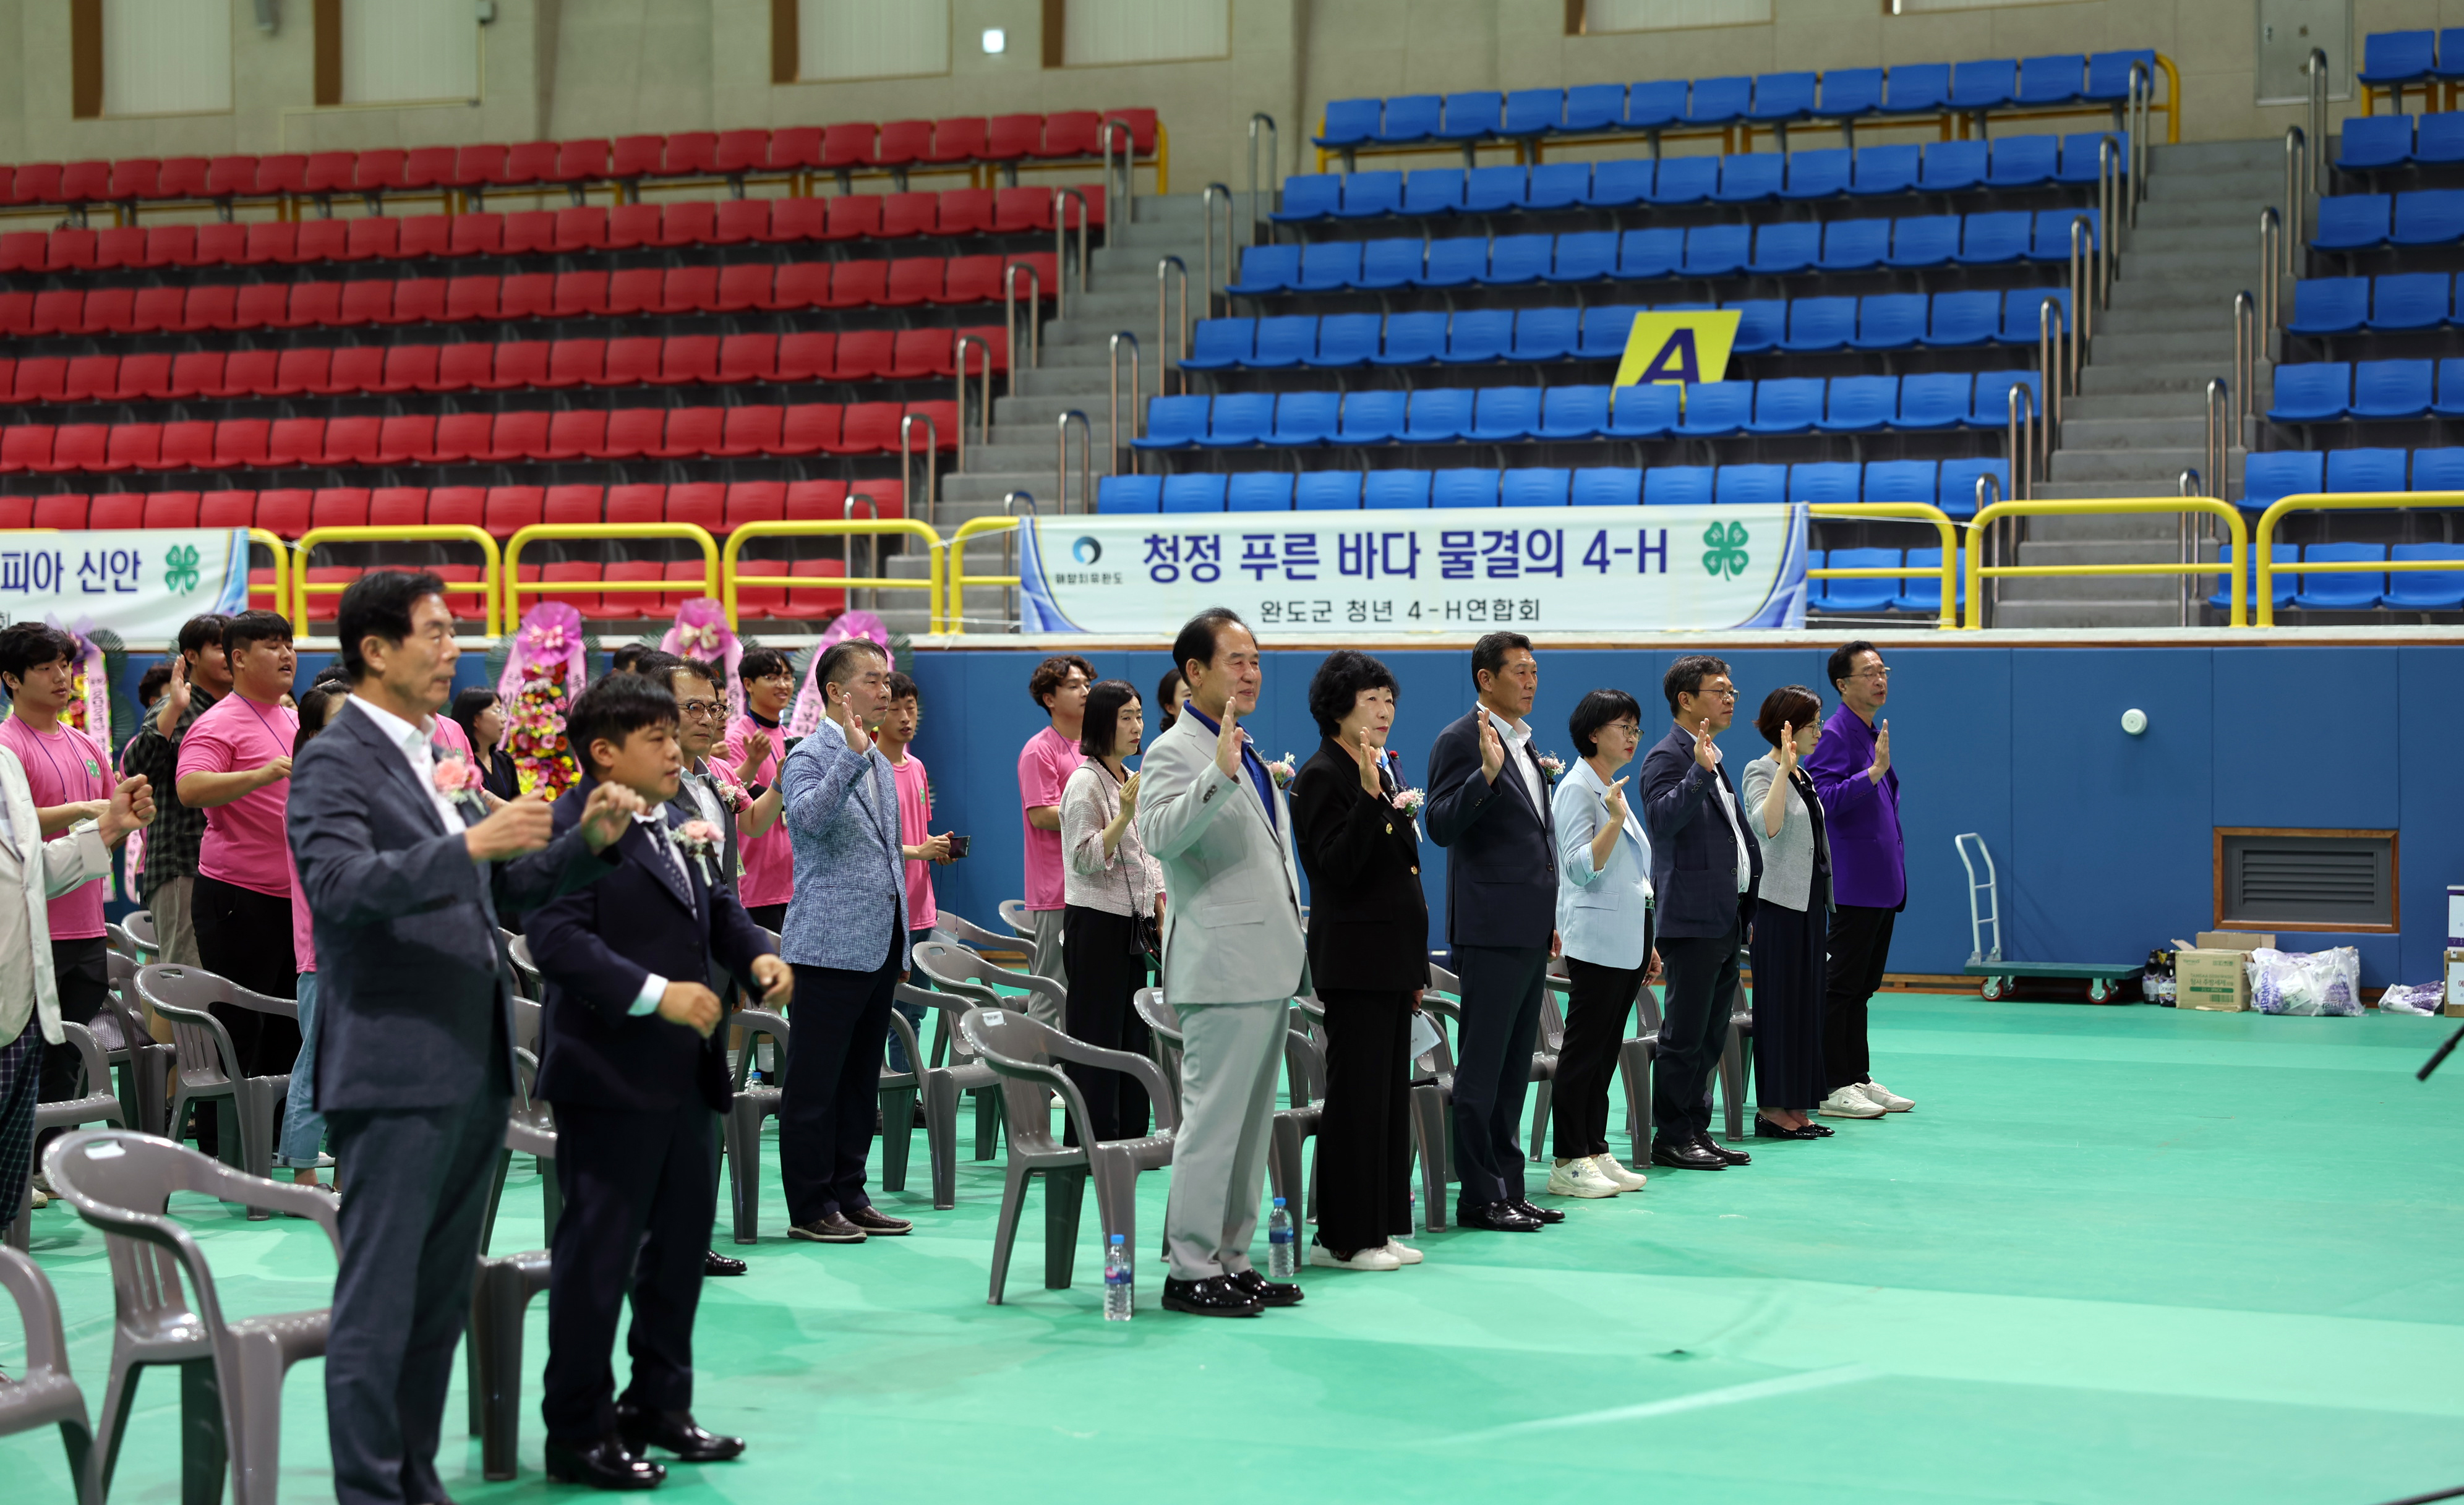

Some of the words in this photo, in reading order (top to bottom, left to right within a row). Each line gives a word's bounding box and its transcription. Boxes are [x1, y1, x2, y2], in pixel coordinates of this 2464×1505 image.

[1635, 328, 1701, 388] A
[1, 552, 64, 594] 피아
[77, 550, 142, 594] 신안
[1143, 533, 1221, 584] 청정
[1240, 532, 1320, 582] 푸른
[1338, 531, 1421, 580] 바다
[1437, 529, 1564, 579] 물결의
[1582, 529, 1667, 574] 4-H
[1260, 600, 1332, 623] 완도군
[1347, 599, 1392, 623] 청년
